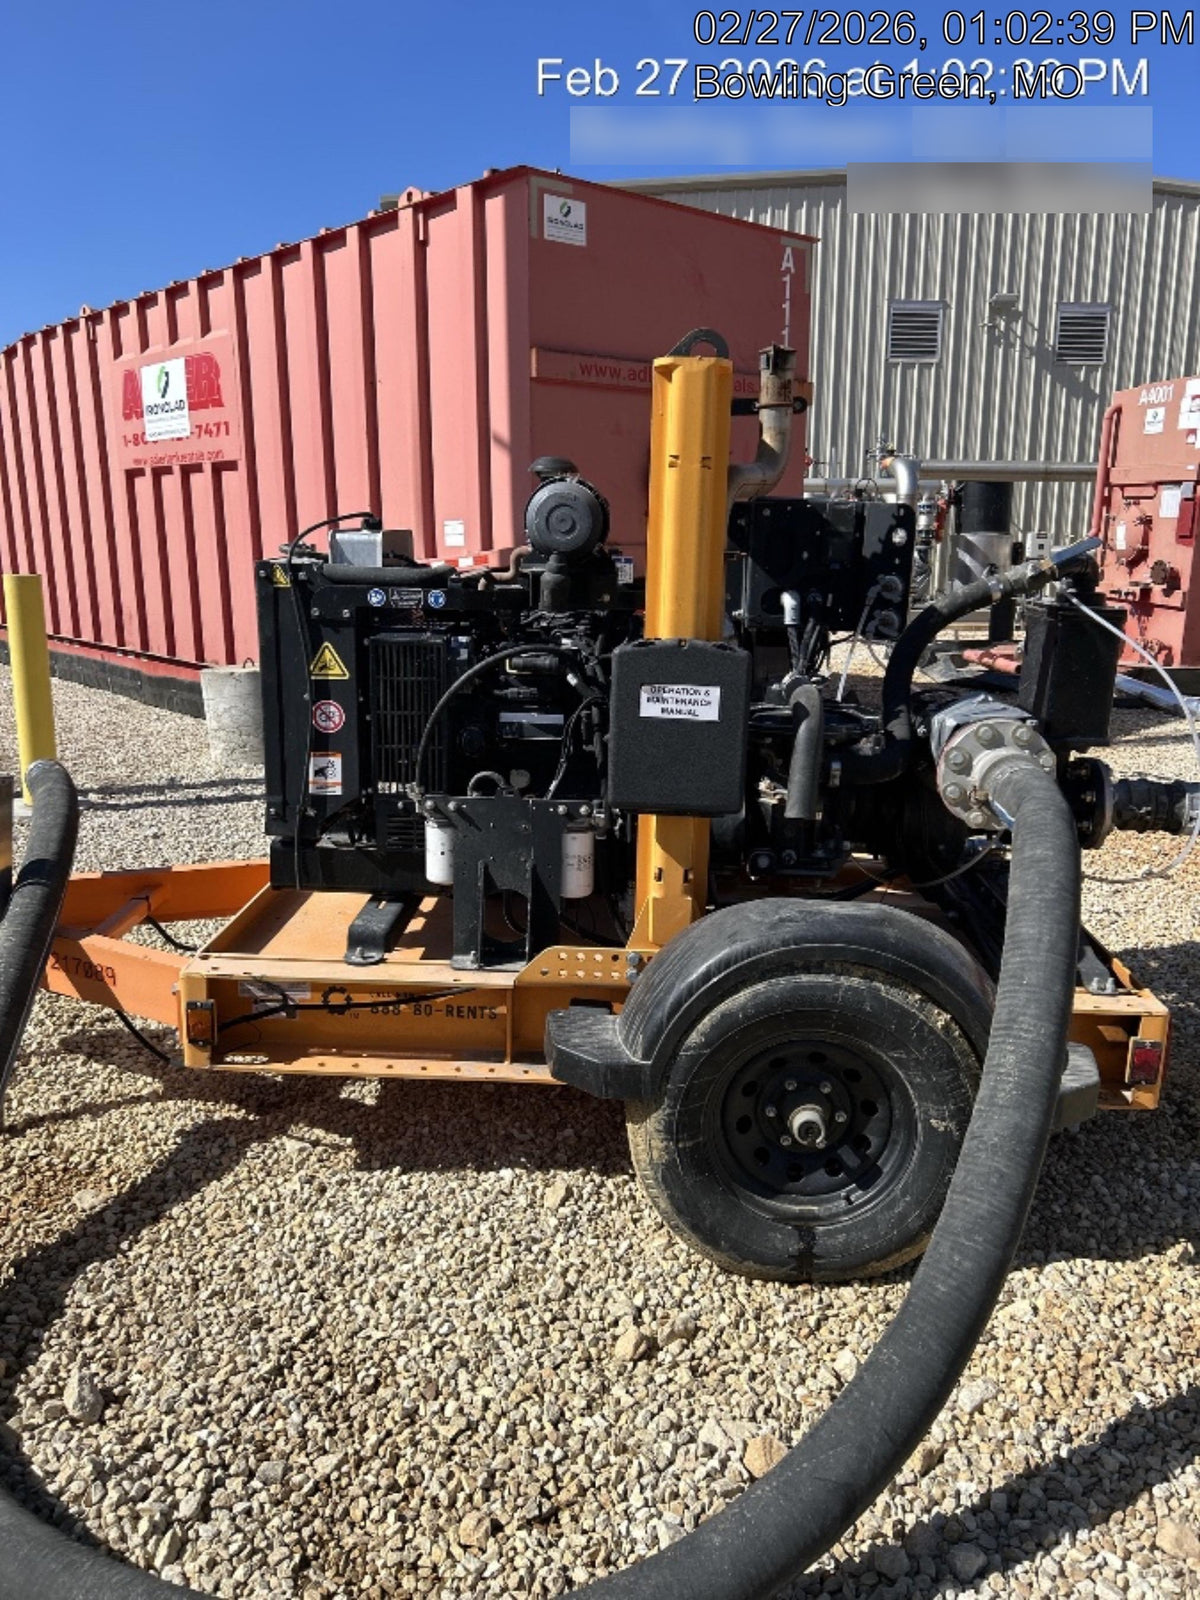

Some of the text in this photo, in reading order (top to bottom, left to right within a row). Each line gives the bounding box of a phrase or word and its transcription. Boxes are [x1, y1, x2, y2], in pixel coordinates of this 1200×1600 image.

[650, 686, 701, 697] OPERATION
[646, 696, 711, 707] MAINTENANCE
[661, 707, 699, 717] MANUAL
